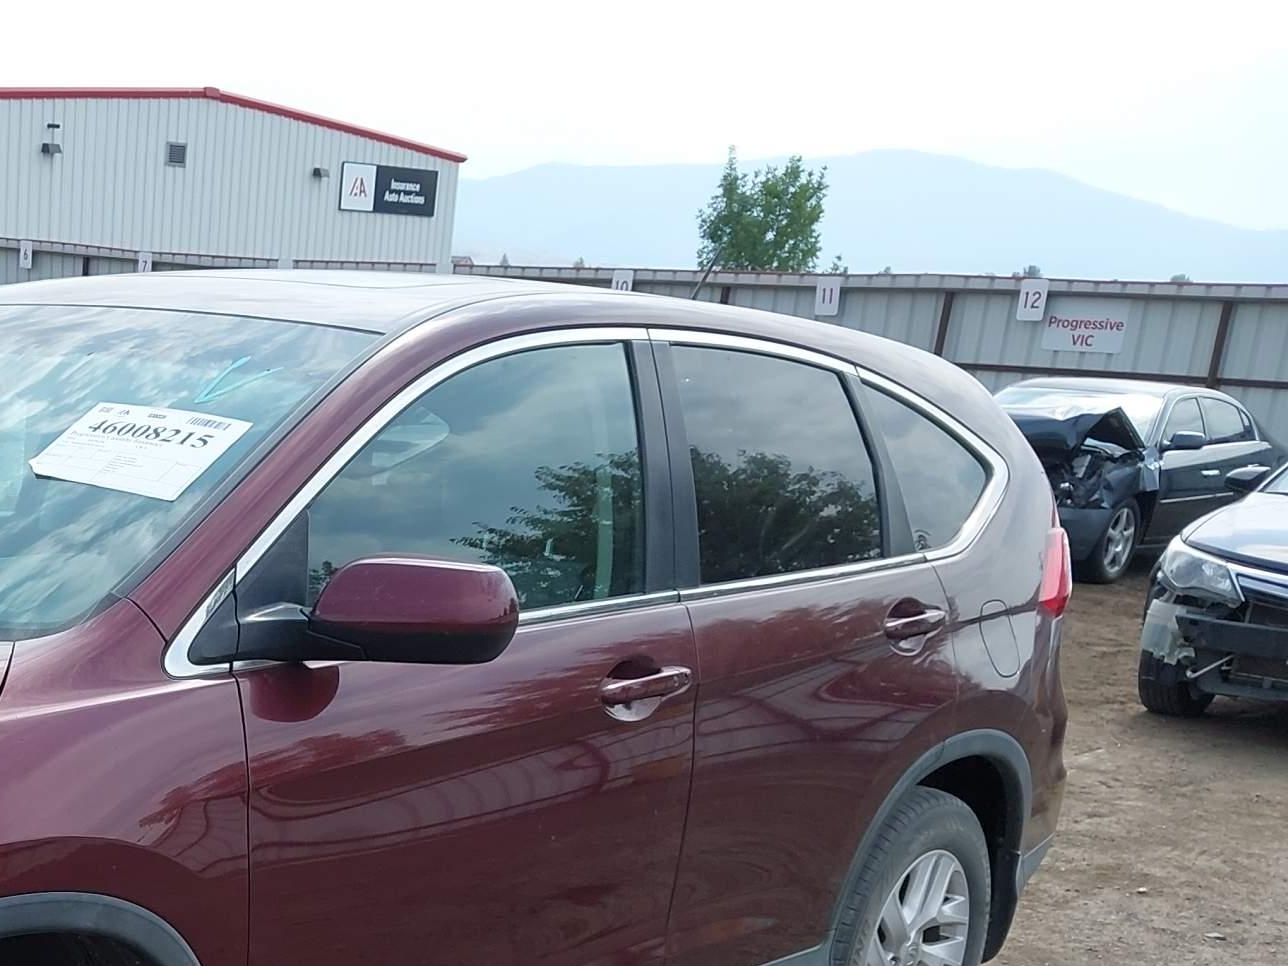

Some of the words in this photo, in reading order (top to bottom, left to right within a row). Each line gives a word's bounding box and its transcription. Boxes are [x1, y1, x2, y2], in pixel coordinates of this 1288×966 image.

[391, 178, 421, 192] Insurance
[383, 190, 399, 203] Auto
[399, 191, 426, 205] Auctions
[23, 248, 29, 261] 6
[142, 260, 148, 273] 7
[615, 279, 629, 292] 10
[822, 287, 833, 305] 11
[1023, 291, 1042, 309] 12
[1048, 315, 1125, 332] Progressive
[1071, 334, 1095, 347] VIC
[88, 418, 216, 449] 46008215
